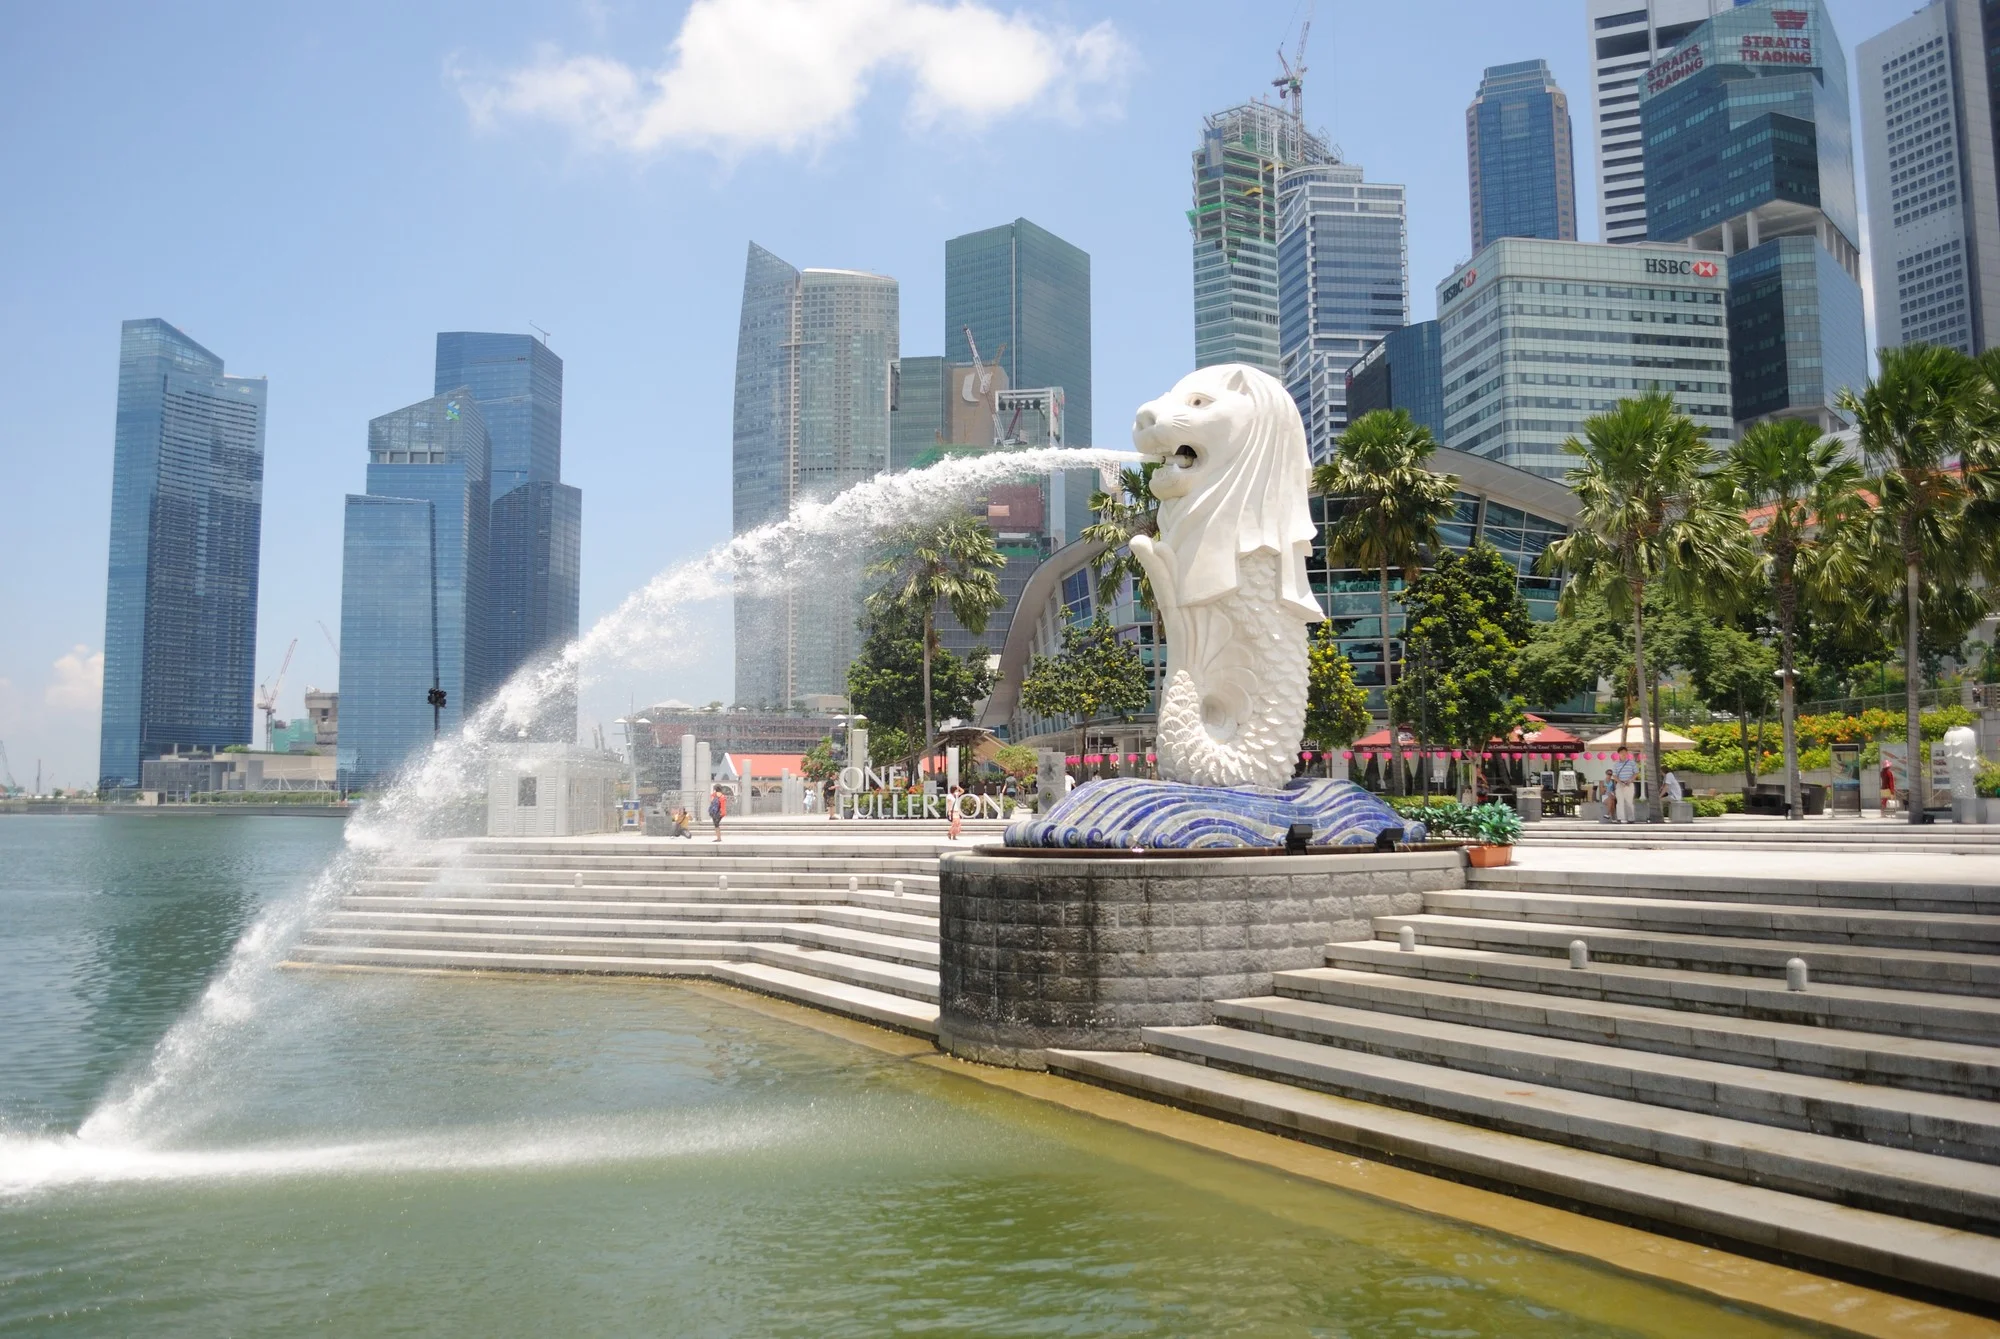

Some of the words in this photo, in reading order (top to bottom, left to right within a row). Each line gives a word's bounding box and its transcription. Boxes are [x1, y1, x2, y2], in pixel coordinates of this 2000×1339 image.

[1742, 35, 1811, 49] STRAITS
[1647, 44, 1700, 81] STRAITS
[1738, 49, 1812, 64] TRADING
[1647, 57, 1704, 94] TRADING
[1644, 258, 1691, 275] HSBC
[1443, 277, 1464, 305] HSBC
[839, 766, 903, 792] ONE
